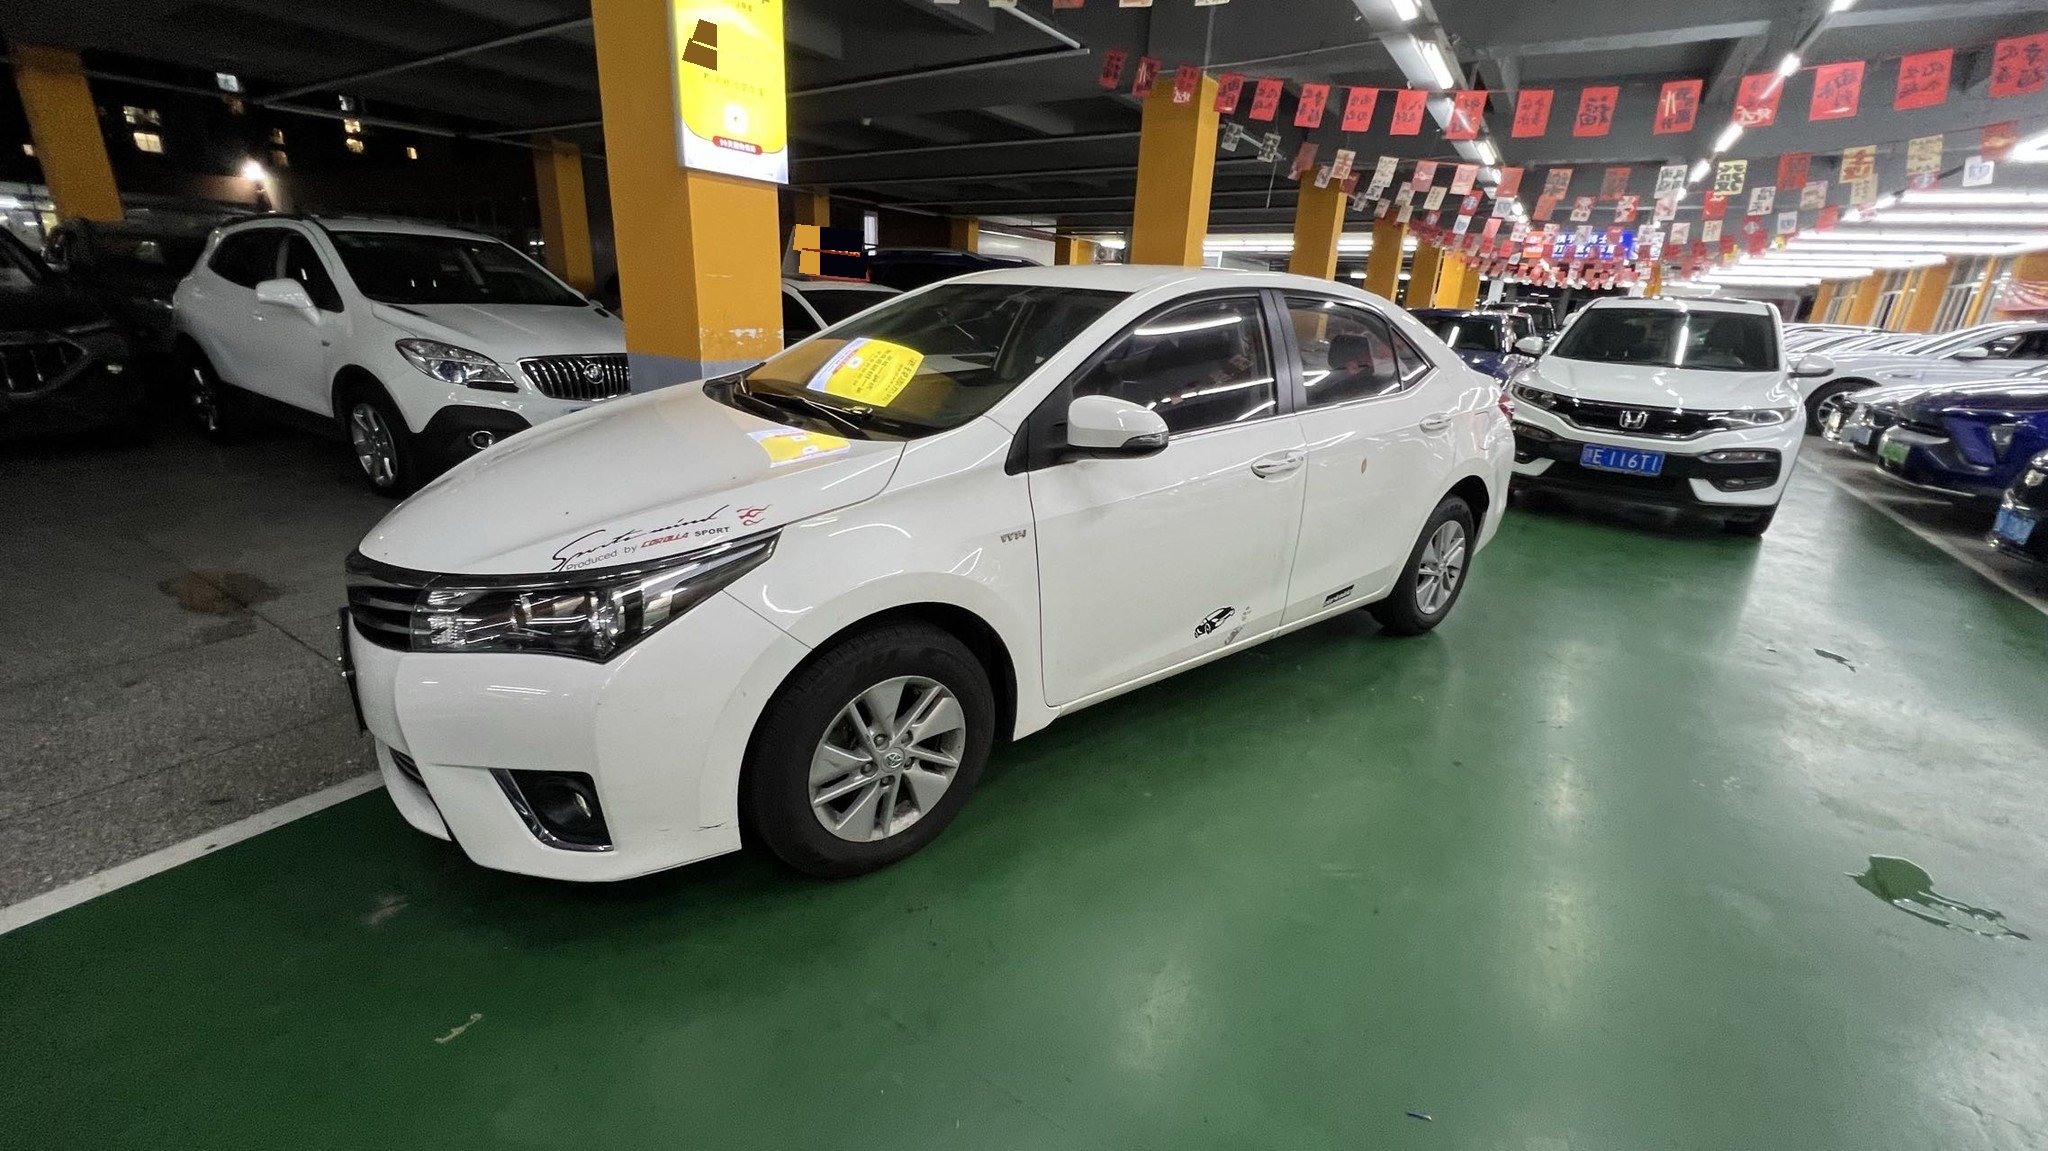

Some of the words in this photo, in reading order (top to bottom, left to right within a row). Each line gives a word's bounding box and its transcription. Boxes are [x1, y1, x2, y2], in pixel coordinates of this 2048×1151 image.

[624, 545, 638, 555] by
[641, 532, 689, 548] COROLLA
[694, 526, 730, 537] SPORT
